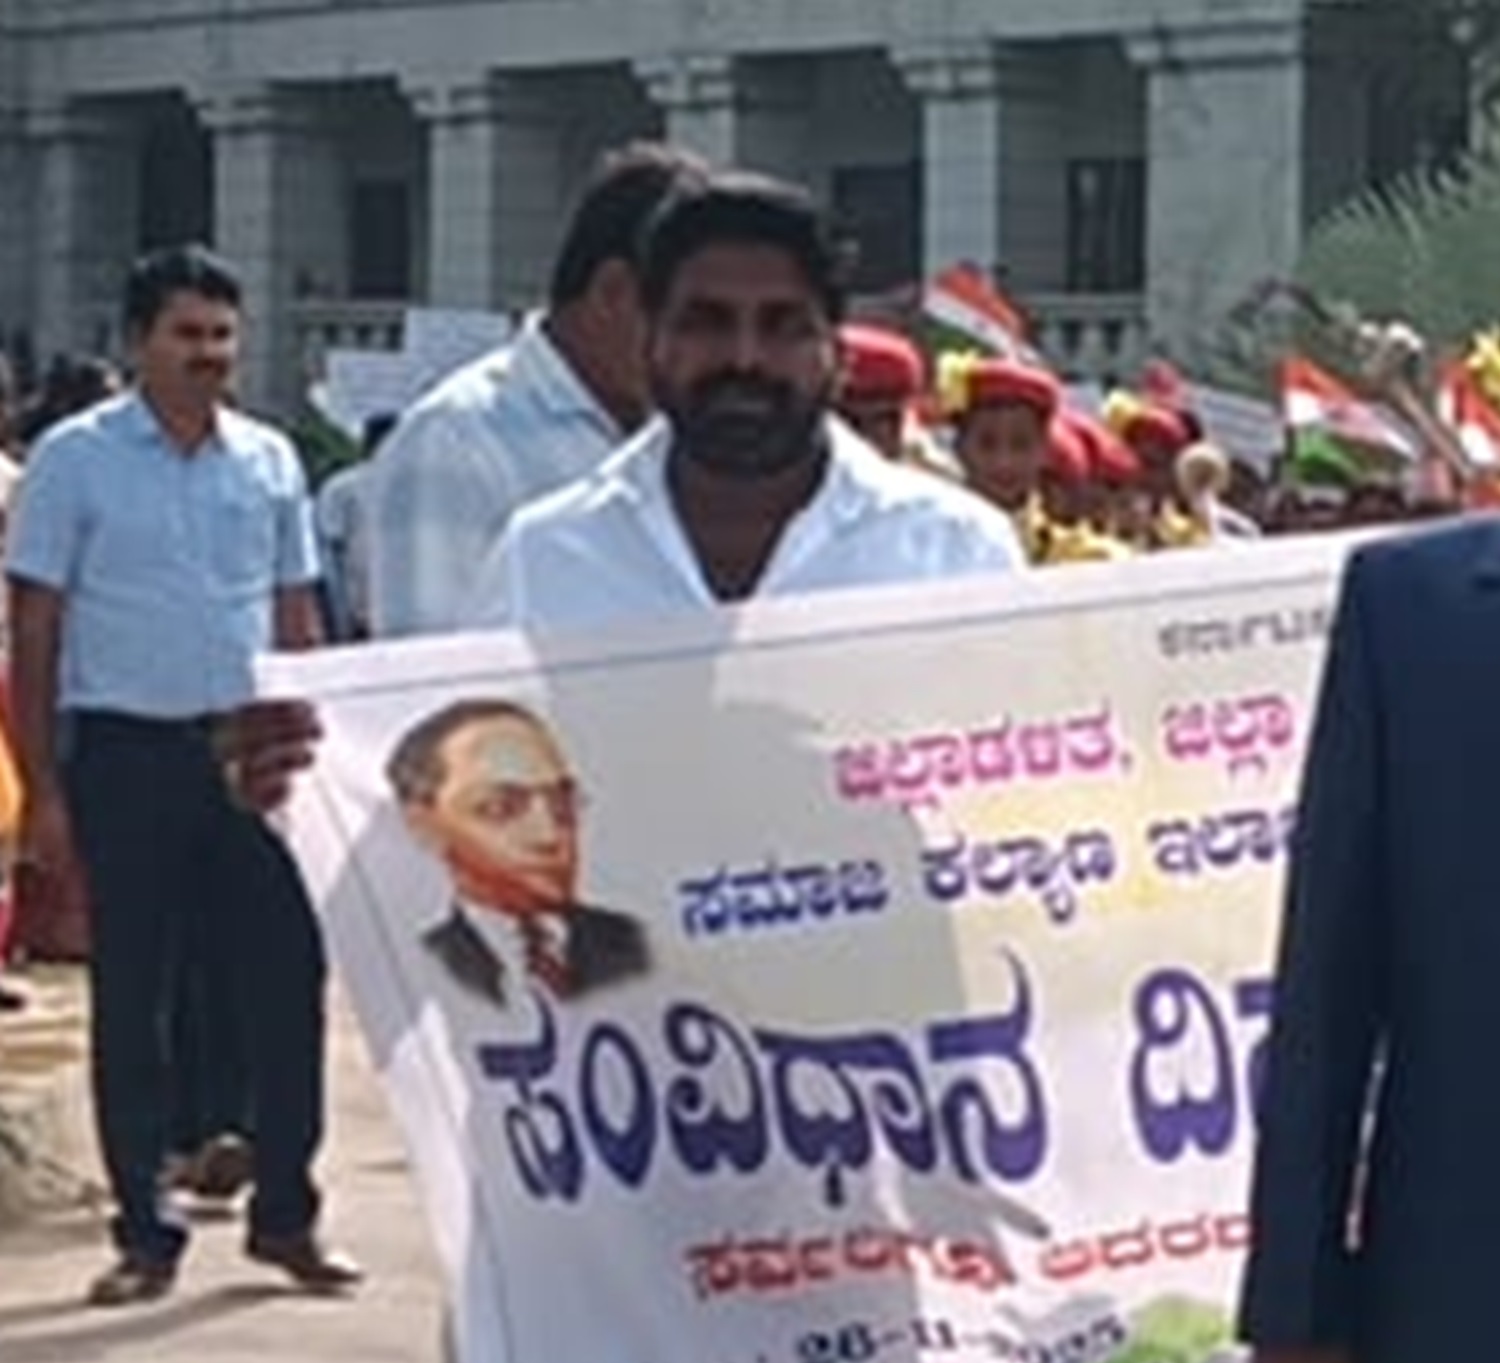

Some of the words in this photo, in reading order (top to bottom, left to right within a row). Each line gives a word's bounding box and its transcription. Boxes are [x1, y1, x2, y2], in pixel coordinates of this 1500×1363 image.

[1160, 692, 1294, 777] ಜಿಲ್ಲಾ
[678, 856, 890, 938] ಸಮಾಜ
[919, 822, 1117, 925] ಕಲ್ಯಾಣ
[480, 946, 1050, 1206] ಸಂವಿಧಾನ
